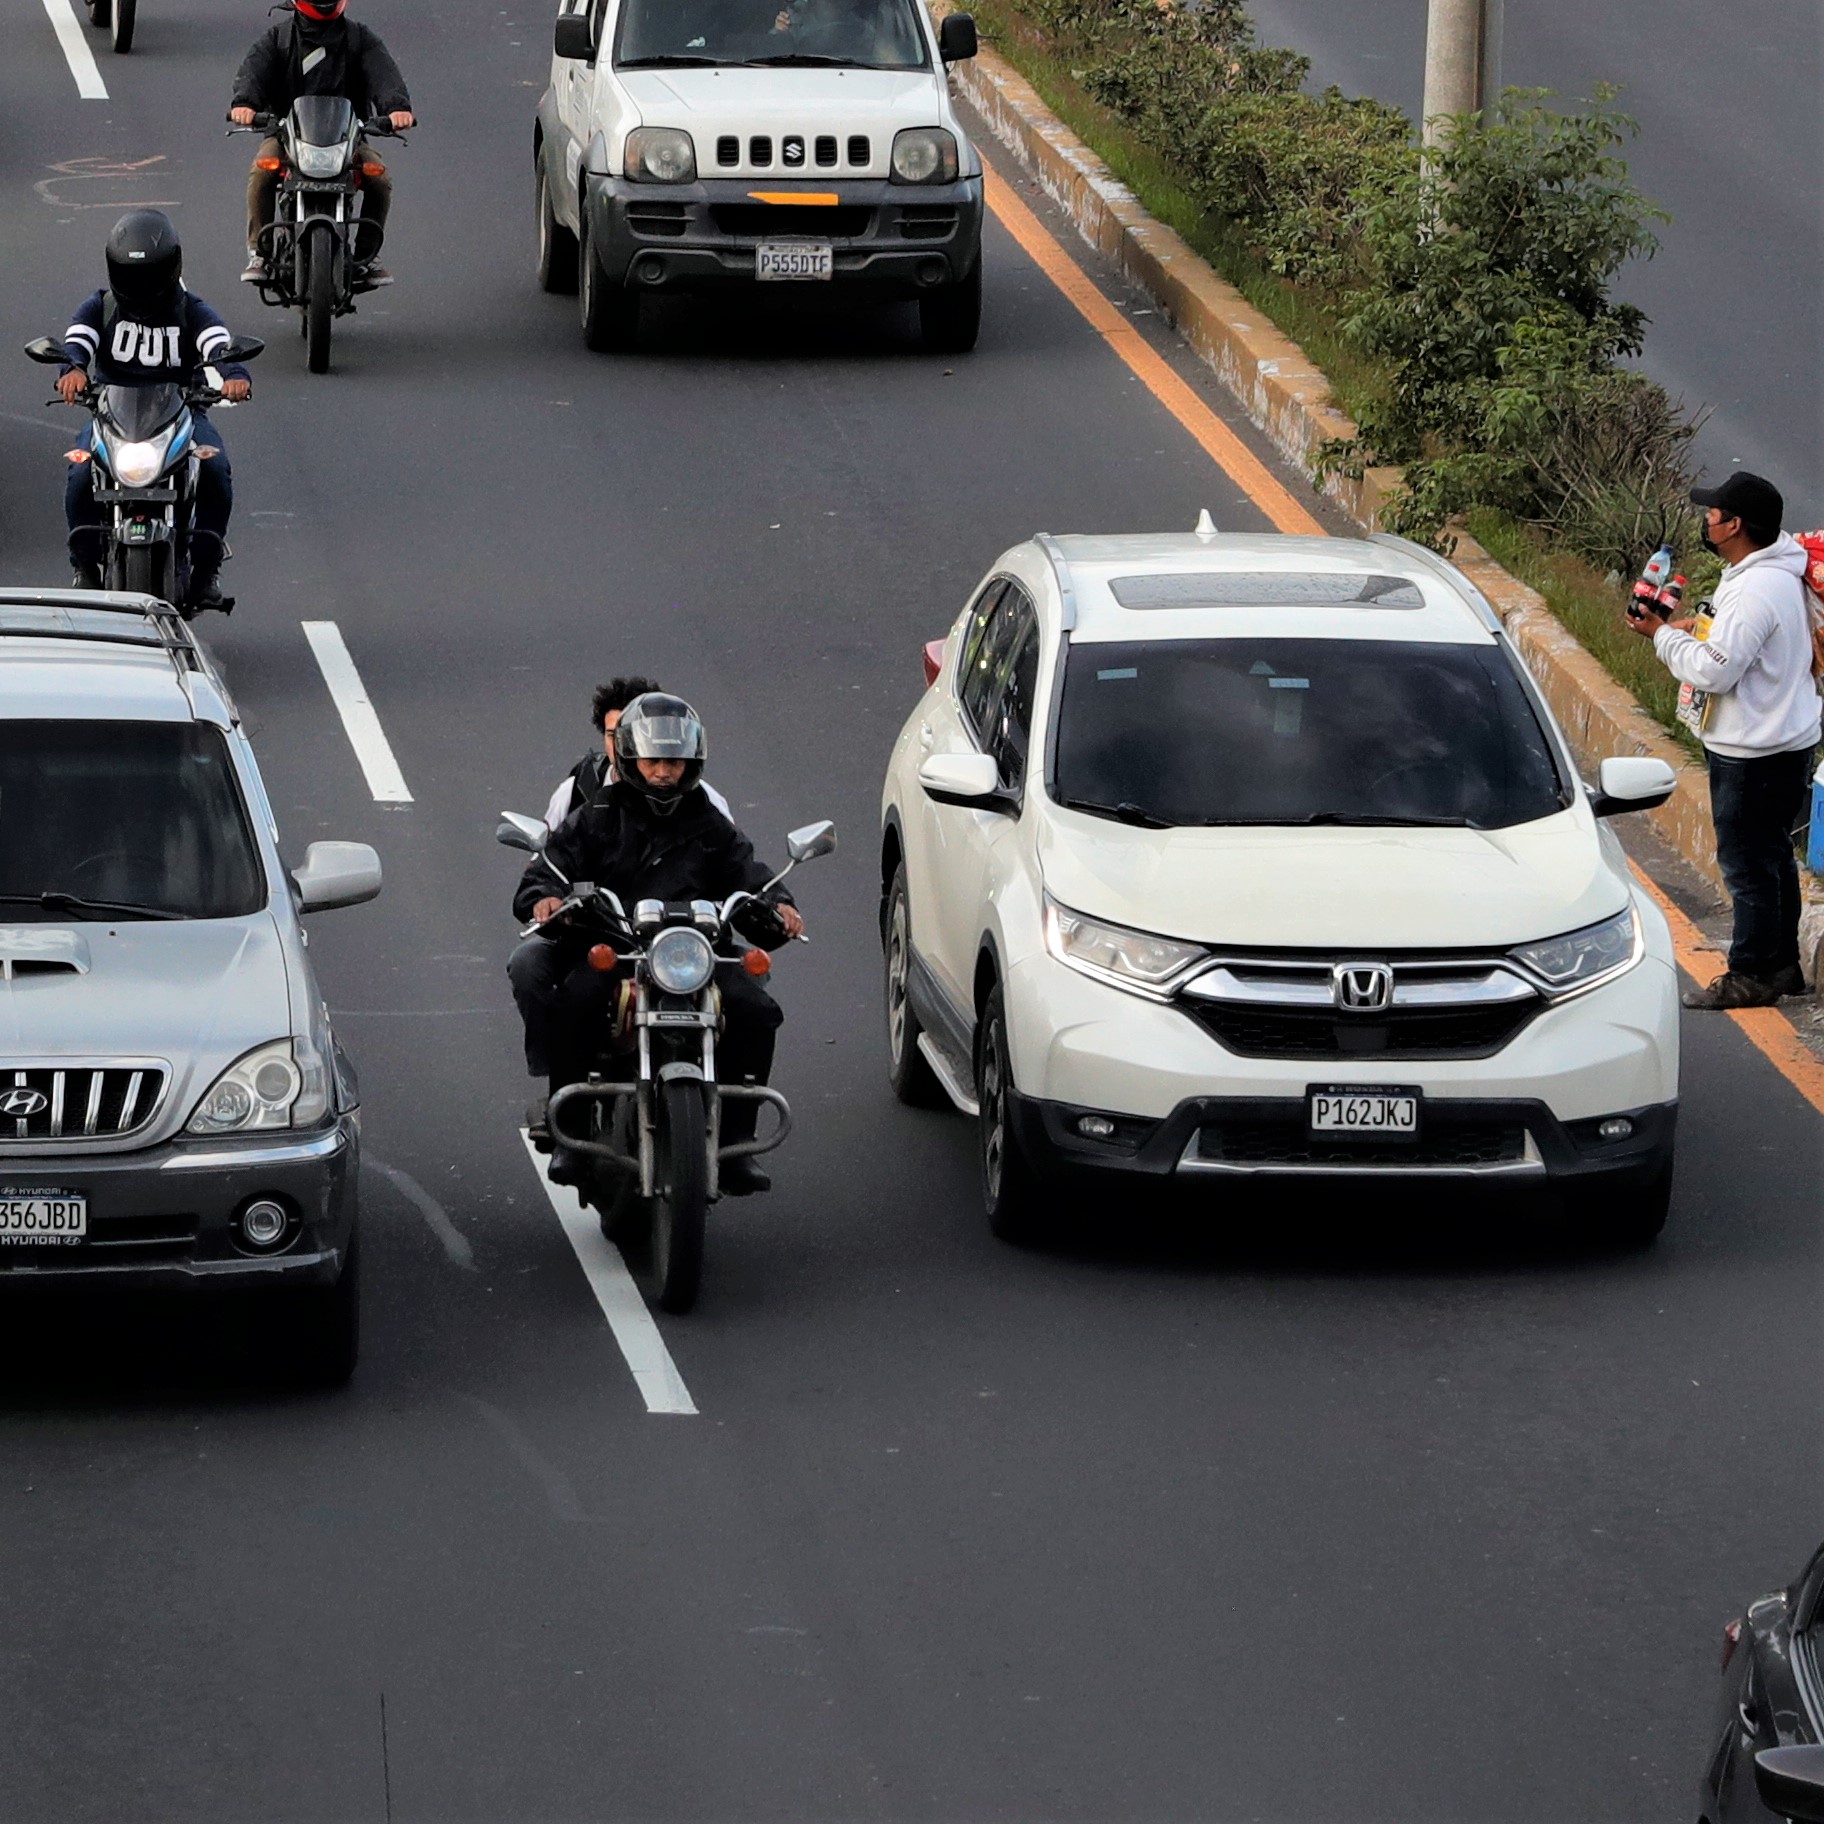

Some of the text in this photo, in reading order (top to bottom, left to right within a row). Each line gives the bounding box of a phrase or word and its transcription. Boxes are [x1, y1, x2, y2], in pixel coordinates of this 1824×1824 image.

[761, 254, 829, 273] P555DTF
[1317, 1098, 1413, 1126] P162JKJ
[1, 1236, 61, 1245] HYUNDAI
